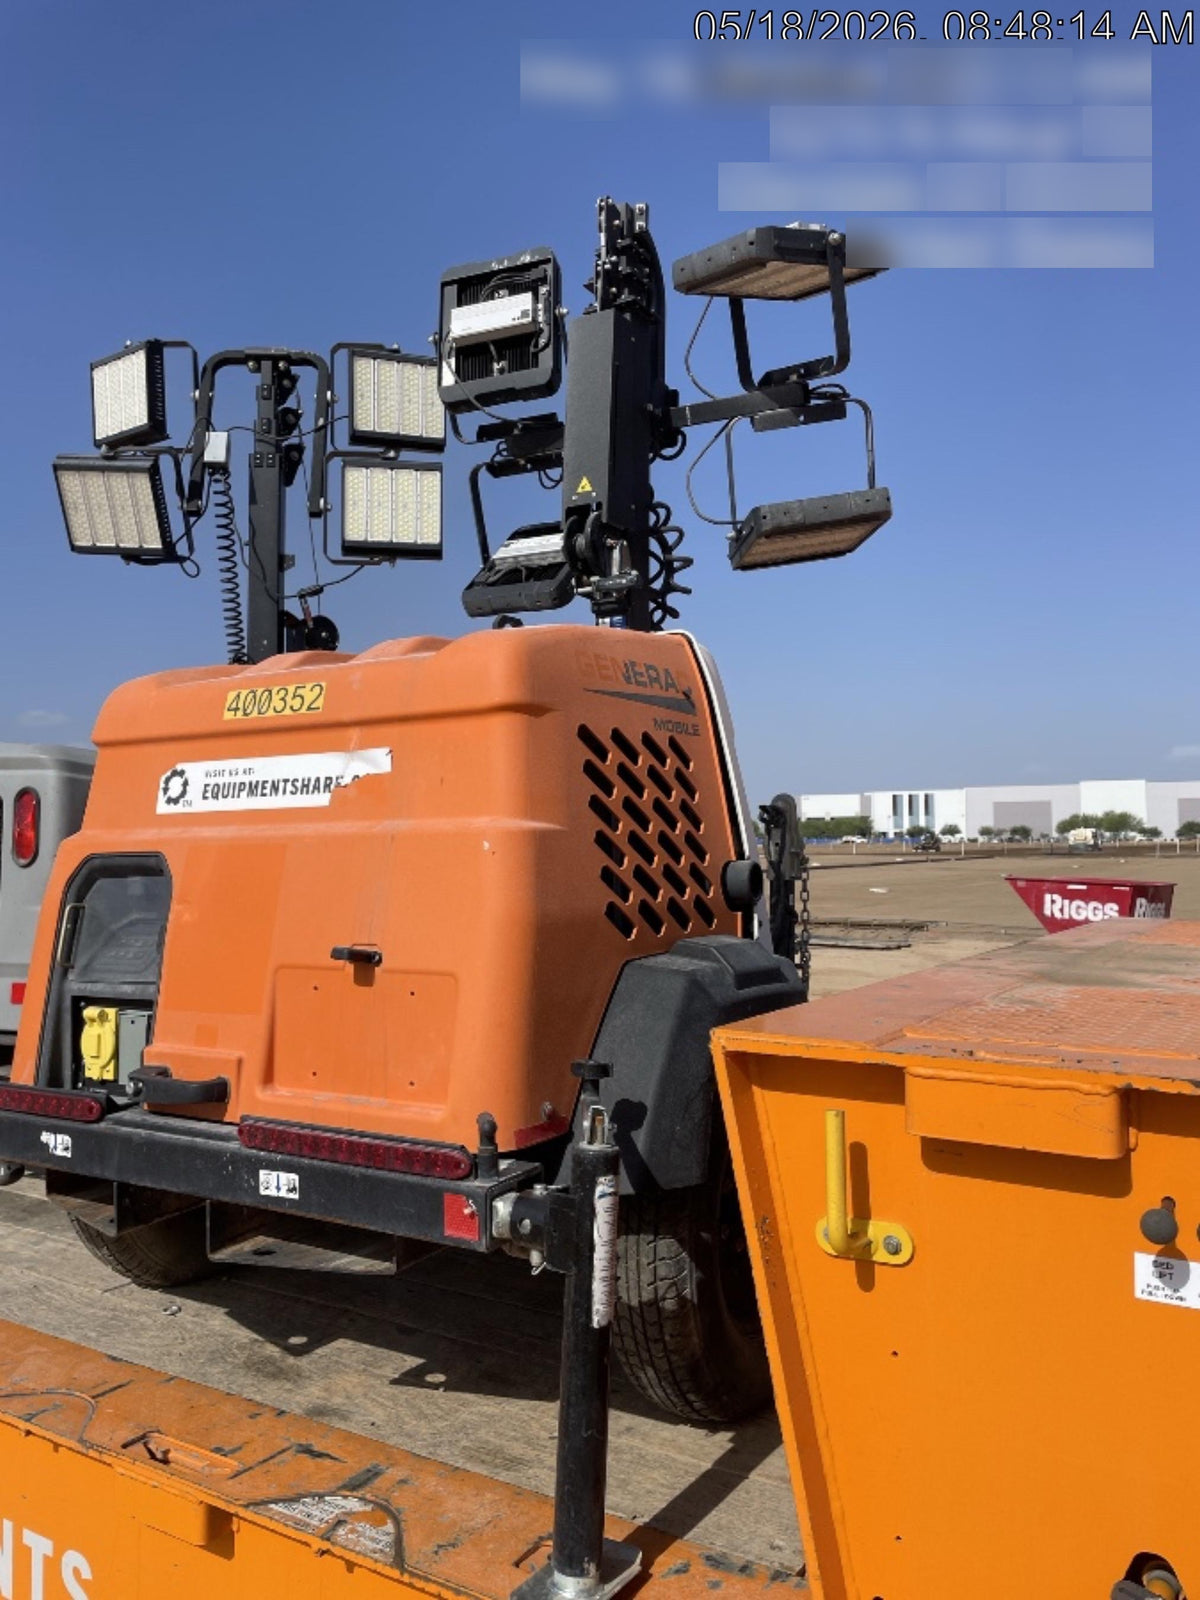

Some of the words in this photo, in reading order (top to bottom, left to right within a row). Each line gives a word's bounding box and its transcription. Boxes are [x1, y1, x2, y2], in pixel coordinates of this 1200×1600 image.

[227, 683, 323, 717] 400352
[653, 717, 700, 737] MOBILE
[205, 769, 226, 778] VISIT
[229, 768, 239, 777] US
[1043, 893, 1119, 921] RIGGS
